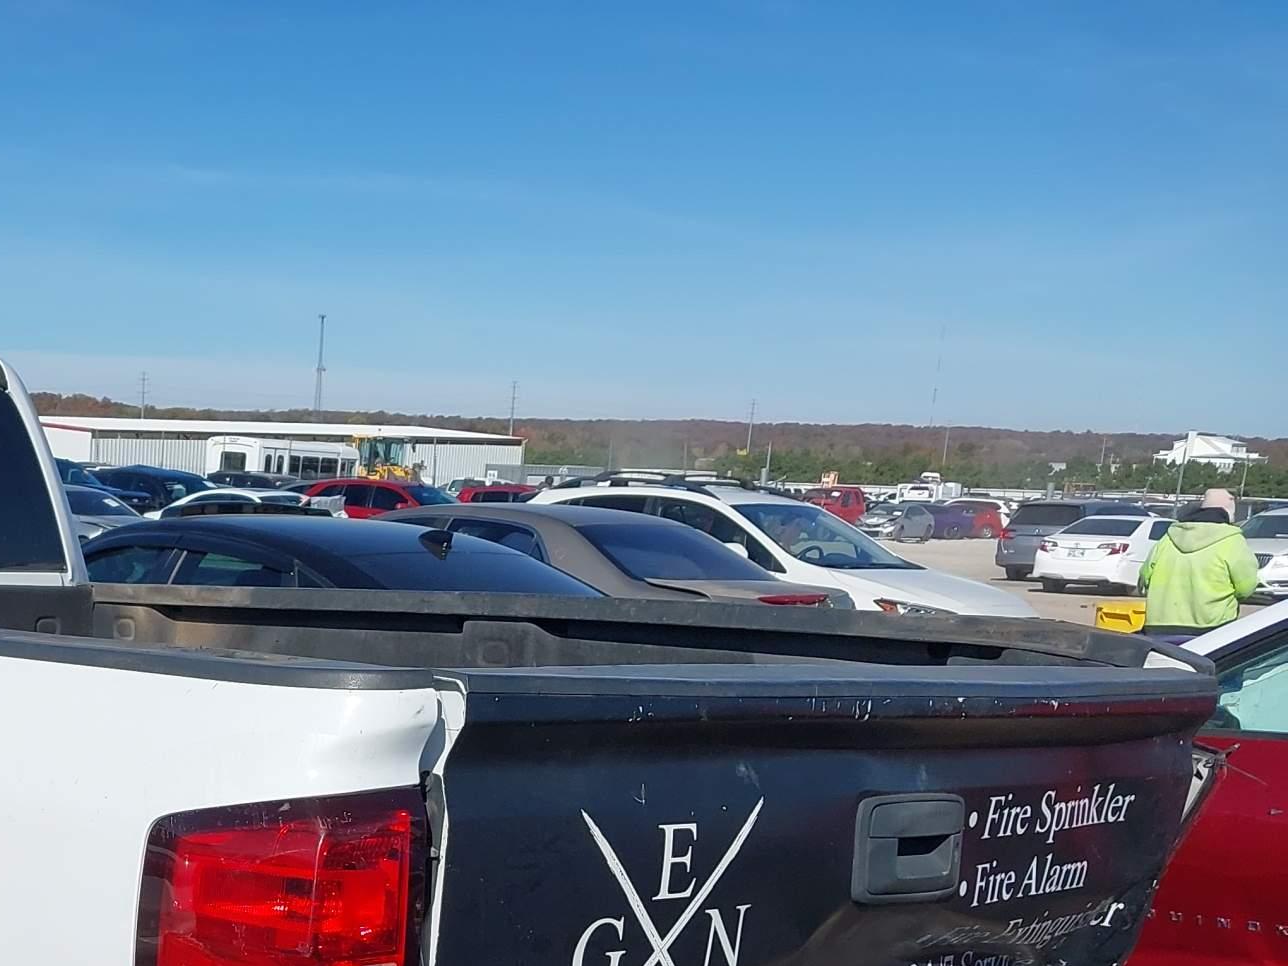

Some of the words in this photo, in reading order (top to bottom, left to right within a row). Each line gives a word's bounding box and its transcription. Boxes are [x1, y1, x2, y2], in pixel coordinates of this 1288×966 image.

[980, 793, 1032, 840] Fire
[1034, 783, 1136, 844] Sprinkler
[969, 860, 1016, 908] Fire
[1015, 853, 1089, 898] Alarm
